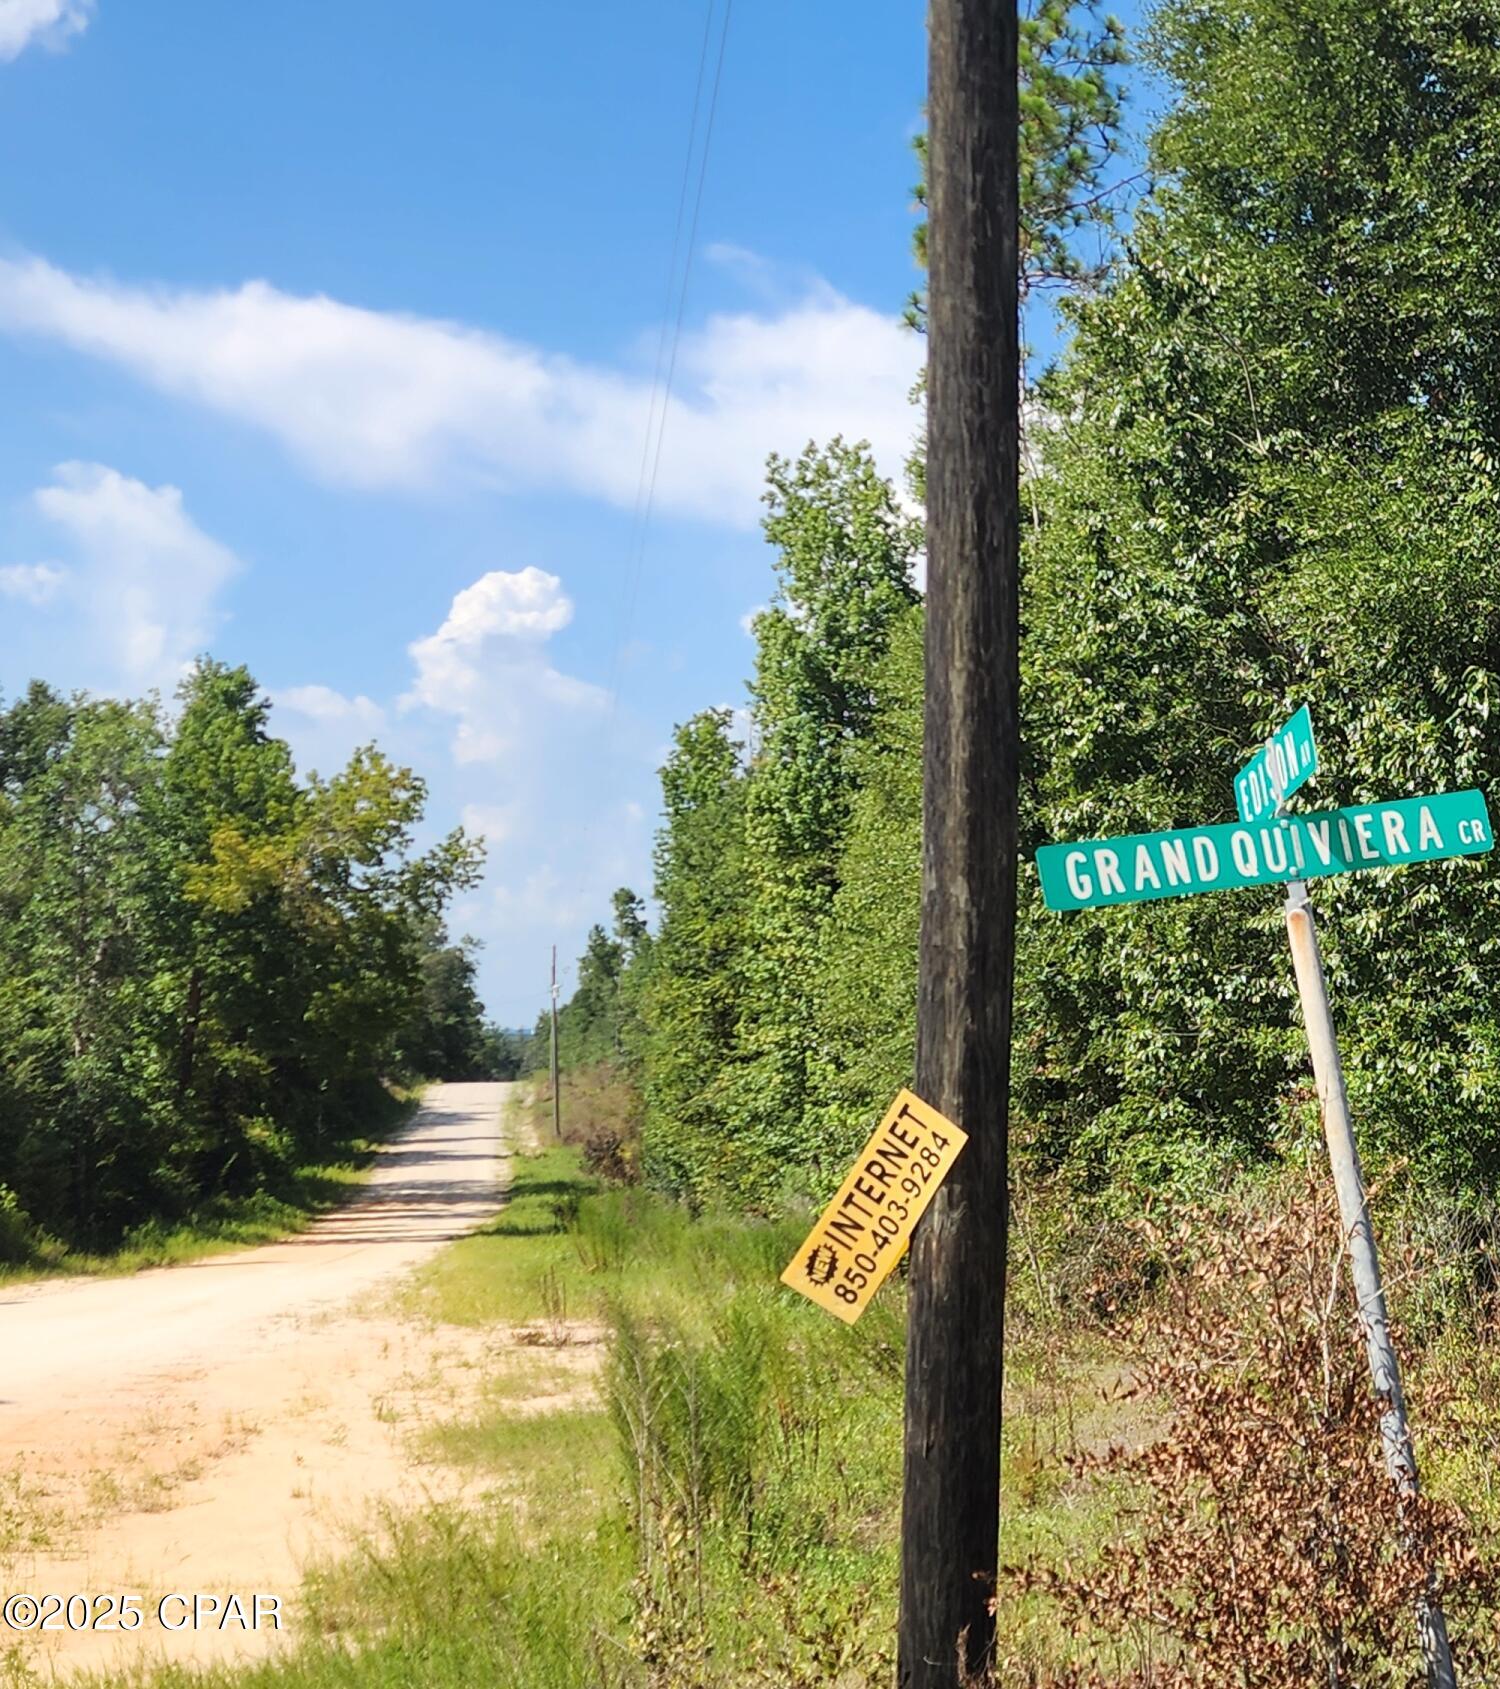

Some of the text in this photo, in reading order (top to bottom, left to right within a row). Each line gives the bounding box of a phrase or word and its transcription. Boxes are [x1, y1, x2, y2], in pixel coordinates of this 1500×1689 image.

[1239, 731, 1299, 822] EDISON
[1065, 805, 1486, 900] GRAND QUIVIERA CR
[823, 1103, 928, 1252] INTERNET
[834, 1131, 951, 1305] 850-403-9284
